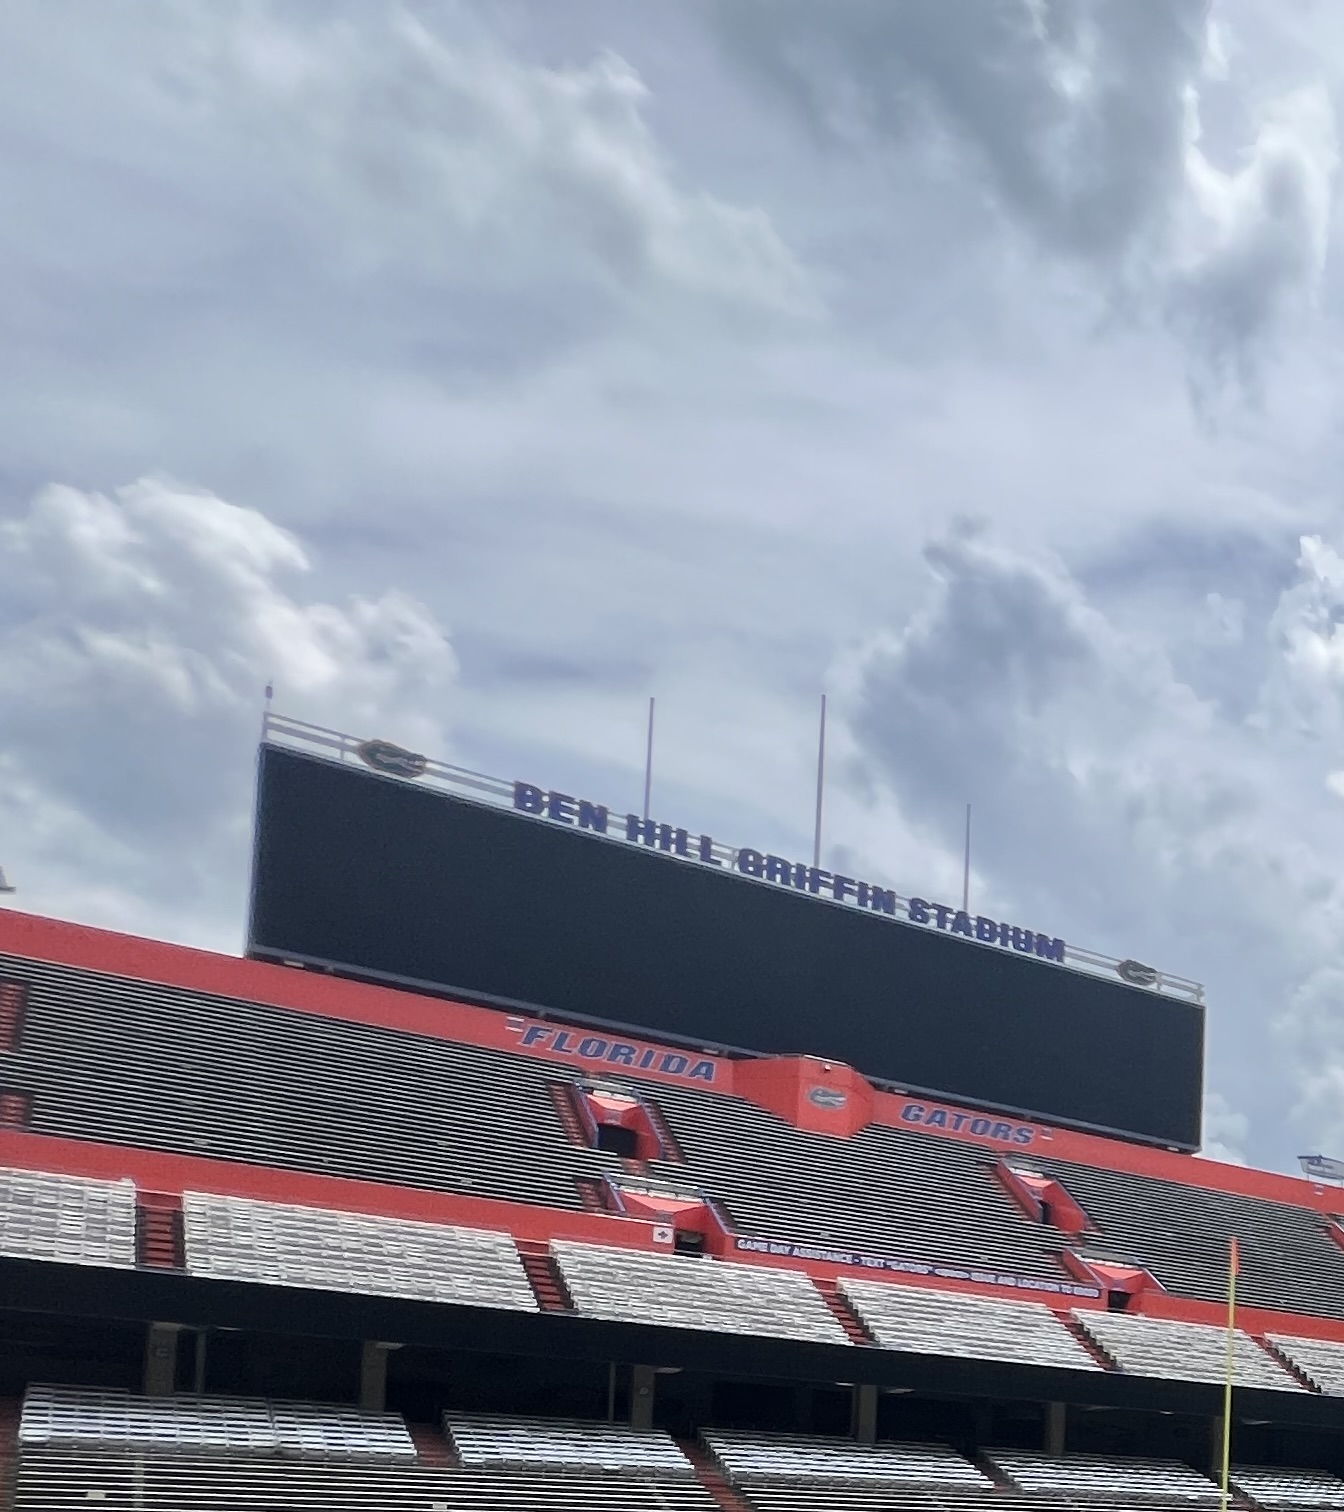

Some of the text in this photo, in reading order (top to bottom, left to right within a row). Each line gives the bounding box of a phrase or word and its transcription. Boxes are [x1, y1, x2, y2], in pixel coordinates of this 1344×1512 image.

[513, 780, 1066, 963] BEN HILL GRIFFIN STADIUM
[522, 1025, 1035, 1146] FLORIDA GATORS
[737, 1238, 768, 1252] GAME
